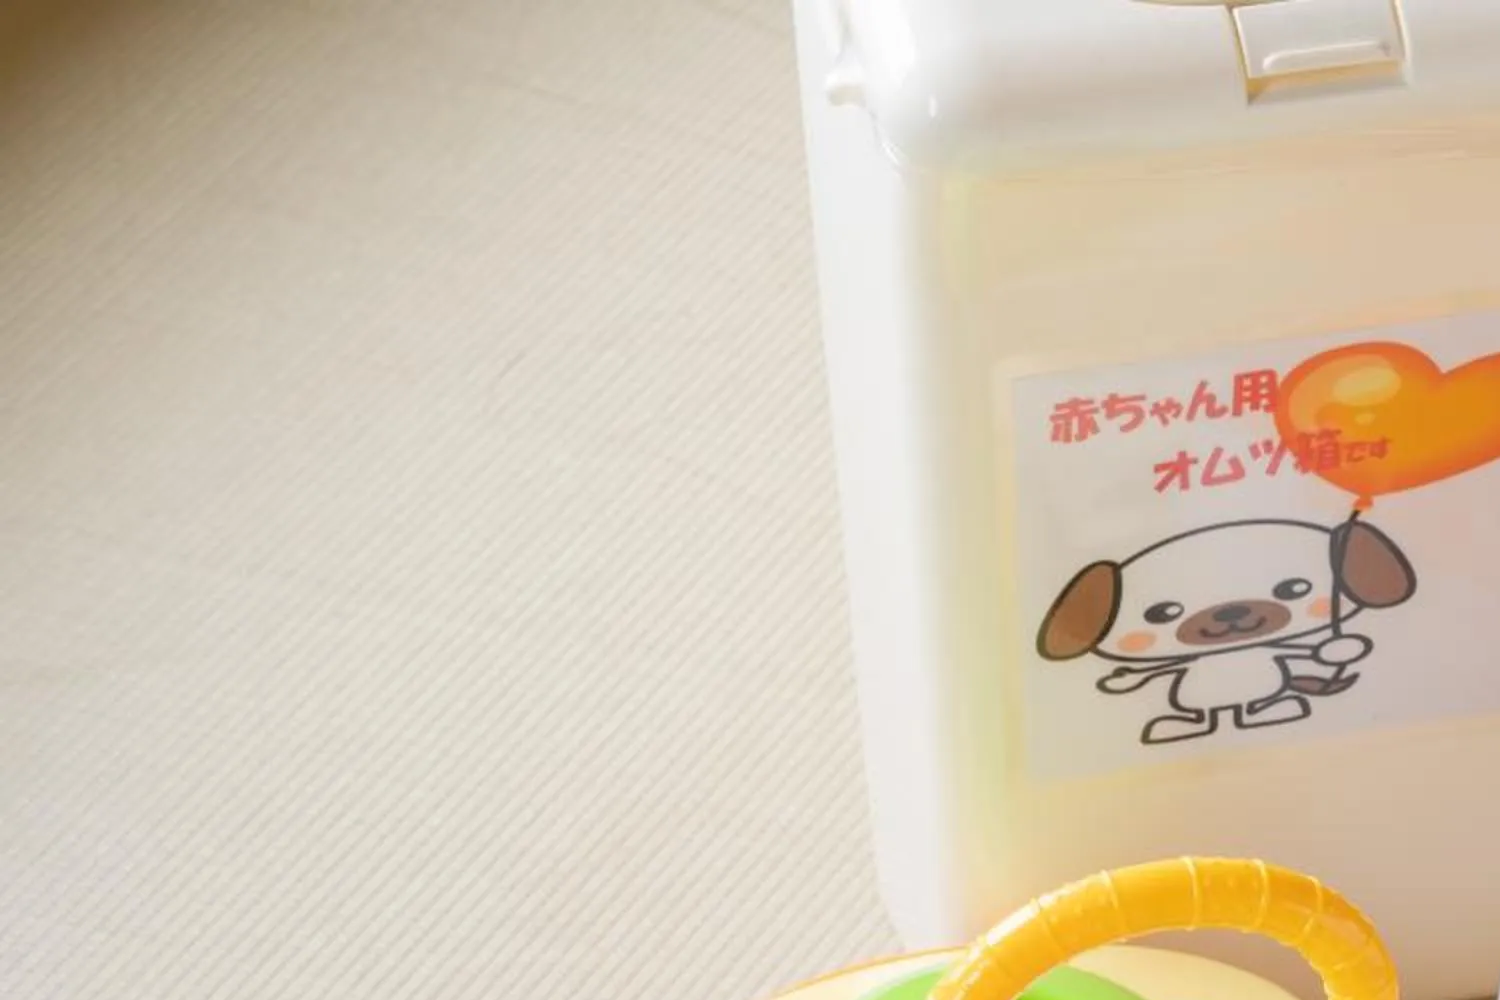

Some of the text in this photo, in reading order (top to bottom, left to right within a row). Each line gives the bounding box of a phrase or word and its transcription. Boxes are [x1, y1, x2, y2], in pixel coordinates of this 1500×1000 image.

[1049, 369, 1280, 444] 赤ちゃん用
[1153, 428, 1392, 493] オムツ箱です
